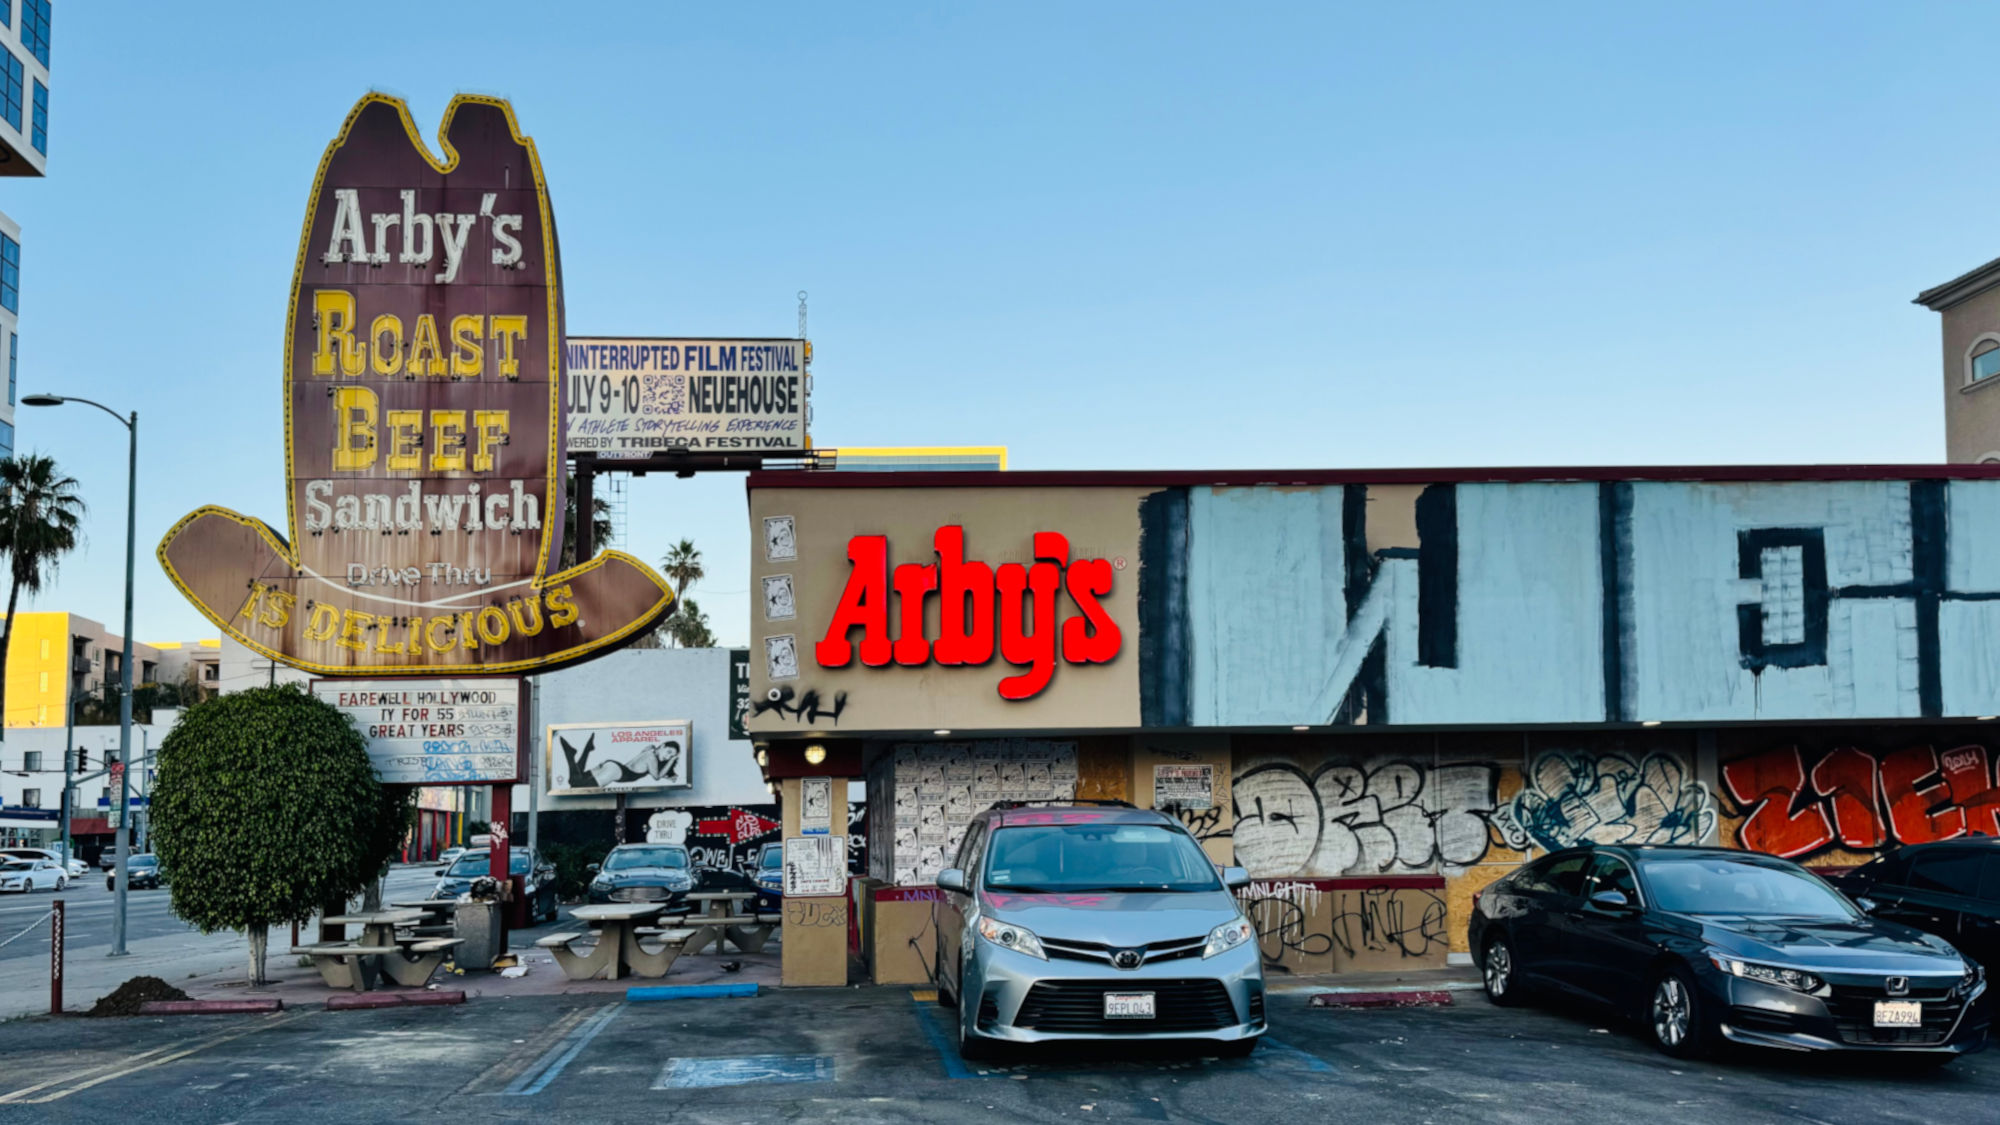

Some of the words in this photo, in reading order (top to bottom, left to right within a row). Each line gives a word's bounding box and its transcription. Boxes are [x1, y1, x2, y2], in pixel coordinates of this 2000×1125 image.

[323, 188, 524, 284] Arby's
[312, 289, 528, 376] ROAST
[566, 344, 680, 371] NINTERRUPTED
[684, 345, 737, 371] FILM
[741, 345, 798, 371] FESTIVAL
[567, 375, 596, 414] ULY
[689, 375, 799, 415] NEUEHOUSE
[331, 385, 510, 472] BEEF
[578, 417, 630, 436] ATHLETE
[634, 417, 720, 437] STORYTELLING
[726, 417, 799, 433] EXPERIENCE
[600, 436, 613, 448] BY
[617, 436, 701, 448] TRIBECA
[705, 436, 798, 448] FESTIVAL
[304, 479, 541, 531] Sandwich
[347, 562, 422, 587] Drive
[425, 561, 492, 585] Thru
[239, 581, 298, 630] IS
[301, 584, 580, 656] DELICIOUS
[815, 524, 1123, 700] Arby's
[339, 692, 412, 706] FAREWELL
[417, 691, 497, 705] HOLLYWOOD
[402, 708, 429, 721] FOR
[437, 708, 455, 721] 55
[369, 724, 416, 738] GREAT
[421, 723, 465, 737] YEARS
[611, 730, 633, 738] LOS
[634, 729, 684, 737] ANGELES
[654, 829, 674, 840] THRU
[656, 819, 677, 829] DRIVE
